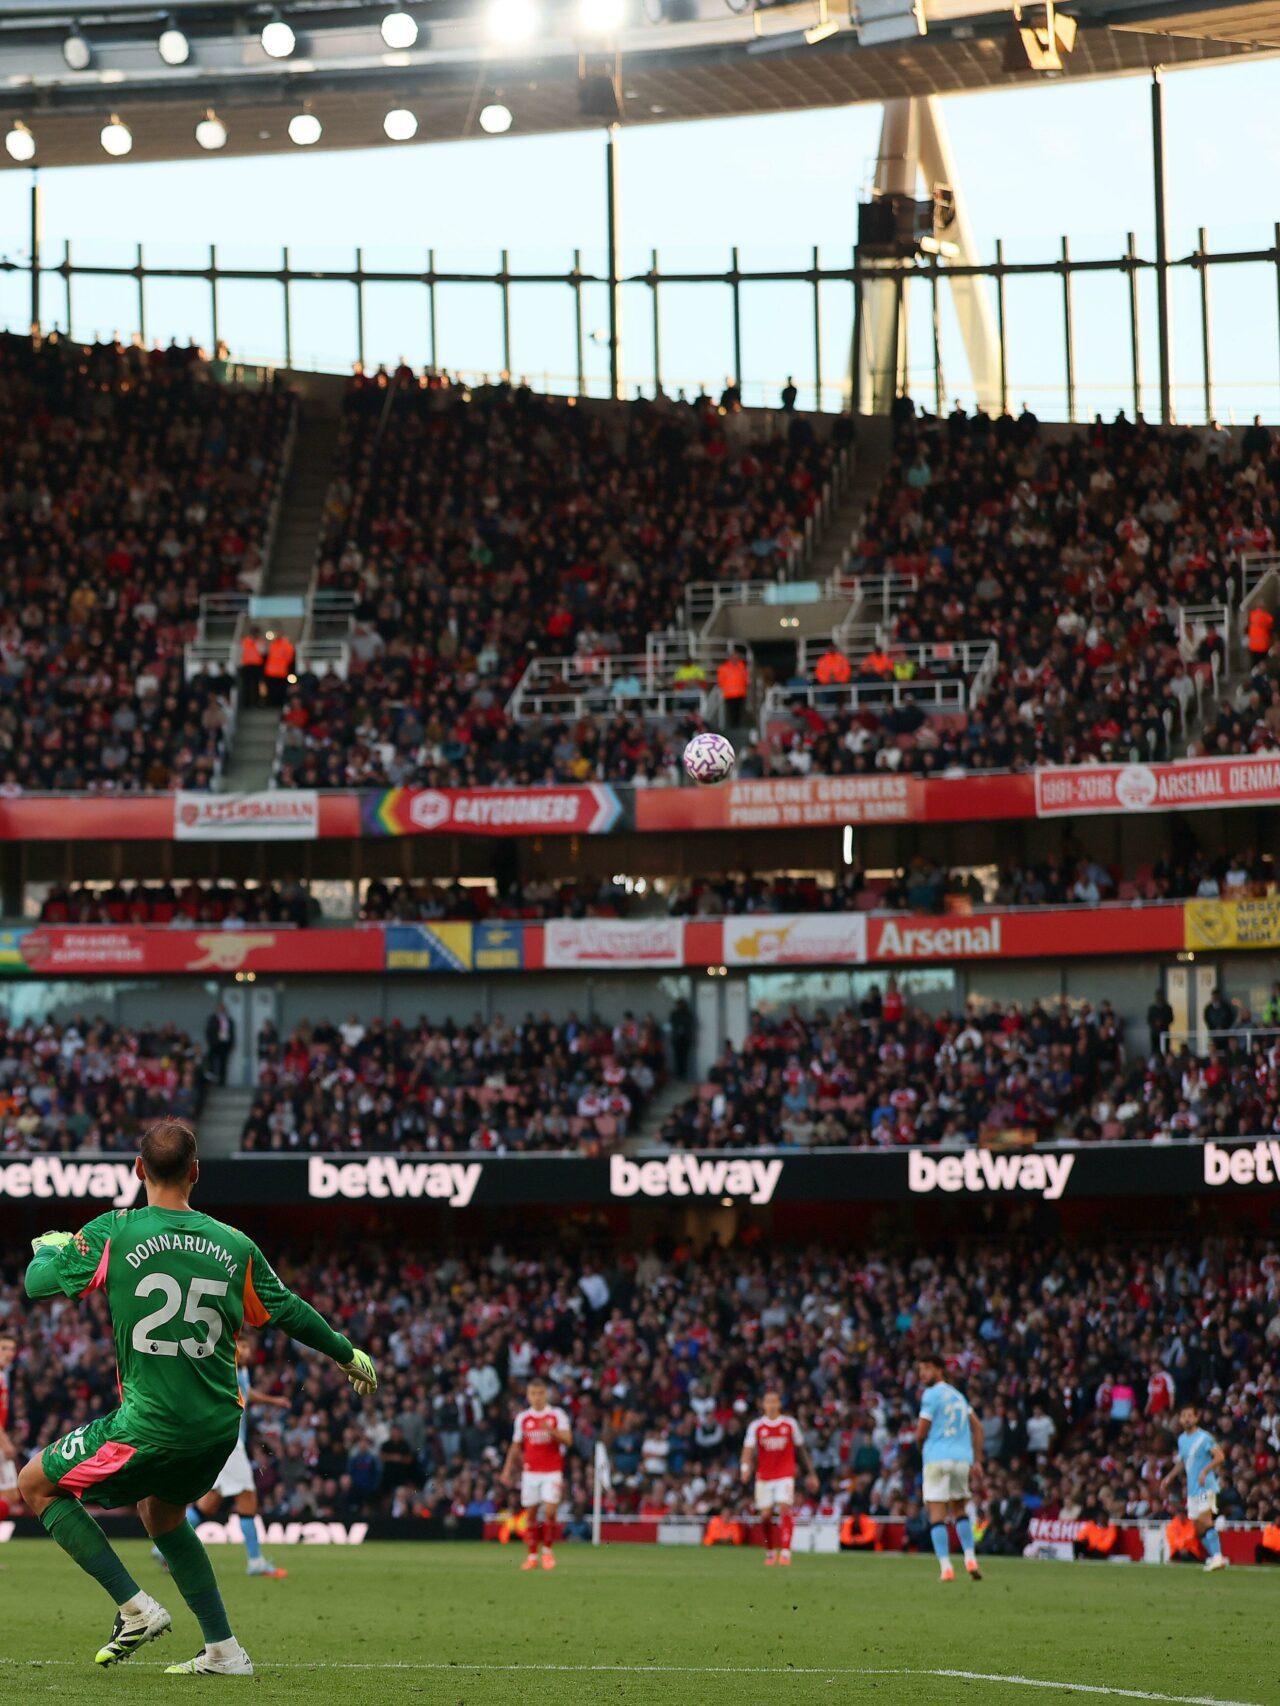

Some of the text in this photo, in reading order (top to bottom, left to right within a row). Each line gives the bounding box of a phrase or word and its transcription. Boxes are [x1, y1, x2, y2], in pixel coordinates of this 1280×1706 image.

[730, 776, 907, 804] ATHLONE GOONERS
[1158, 769, 1224, 799] ARSENAL
[454, 795, 580, 825] GAYGOONERS
[730, 805, 779, 825] PROUD
[782, 804, 801, 823] TO
[877, 917, 1001, 956] Arsenal
[309, 1156, 482, 1207] betway
[610, 1153, 783, 1204] betway
[908, 1149, 1075, 1199] betway
[1204, 1141, 1280, 1186] bet
[125, 1234, 238, 1278] DONNARUMMA
[132, 1272, 229, 1359] 25
